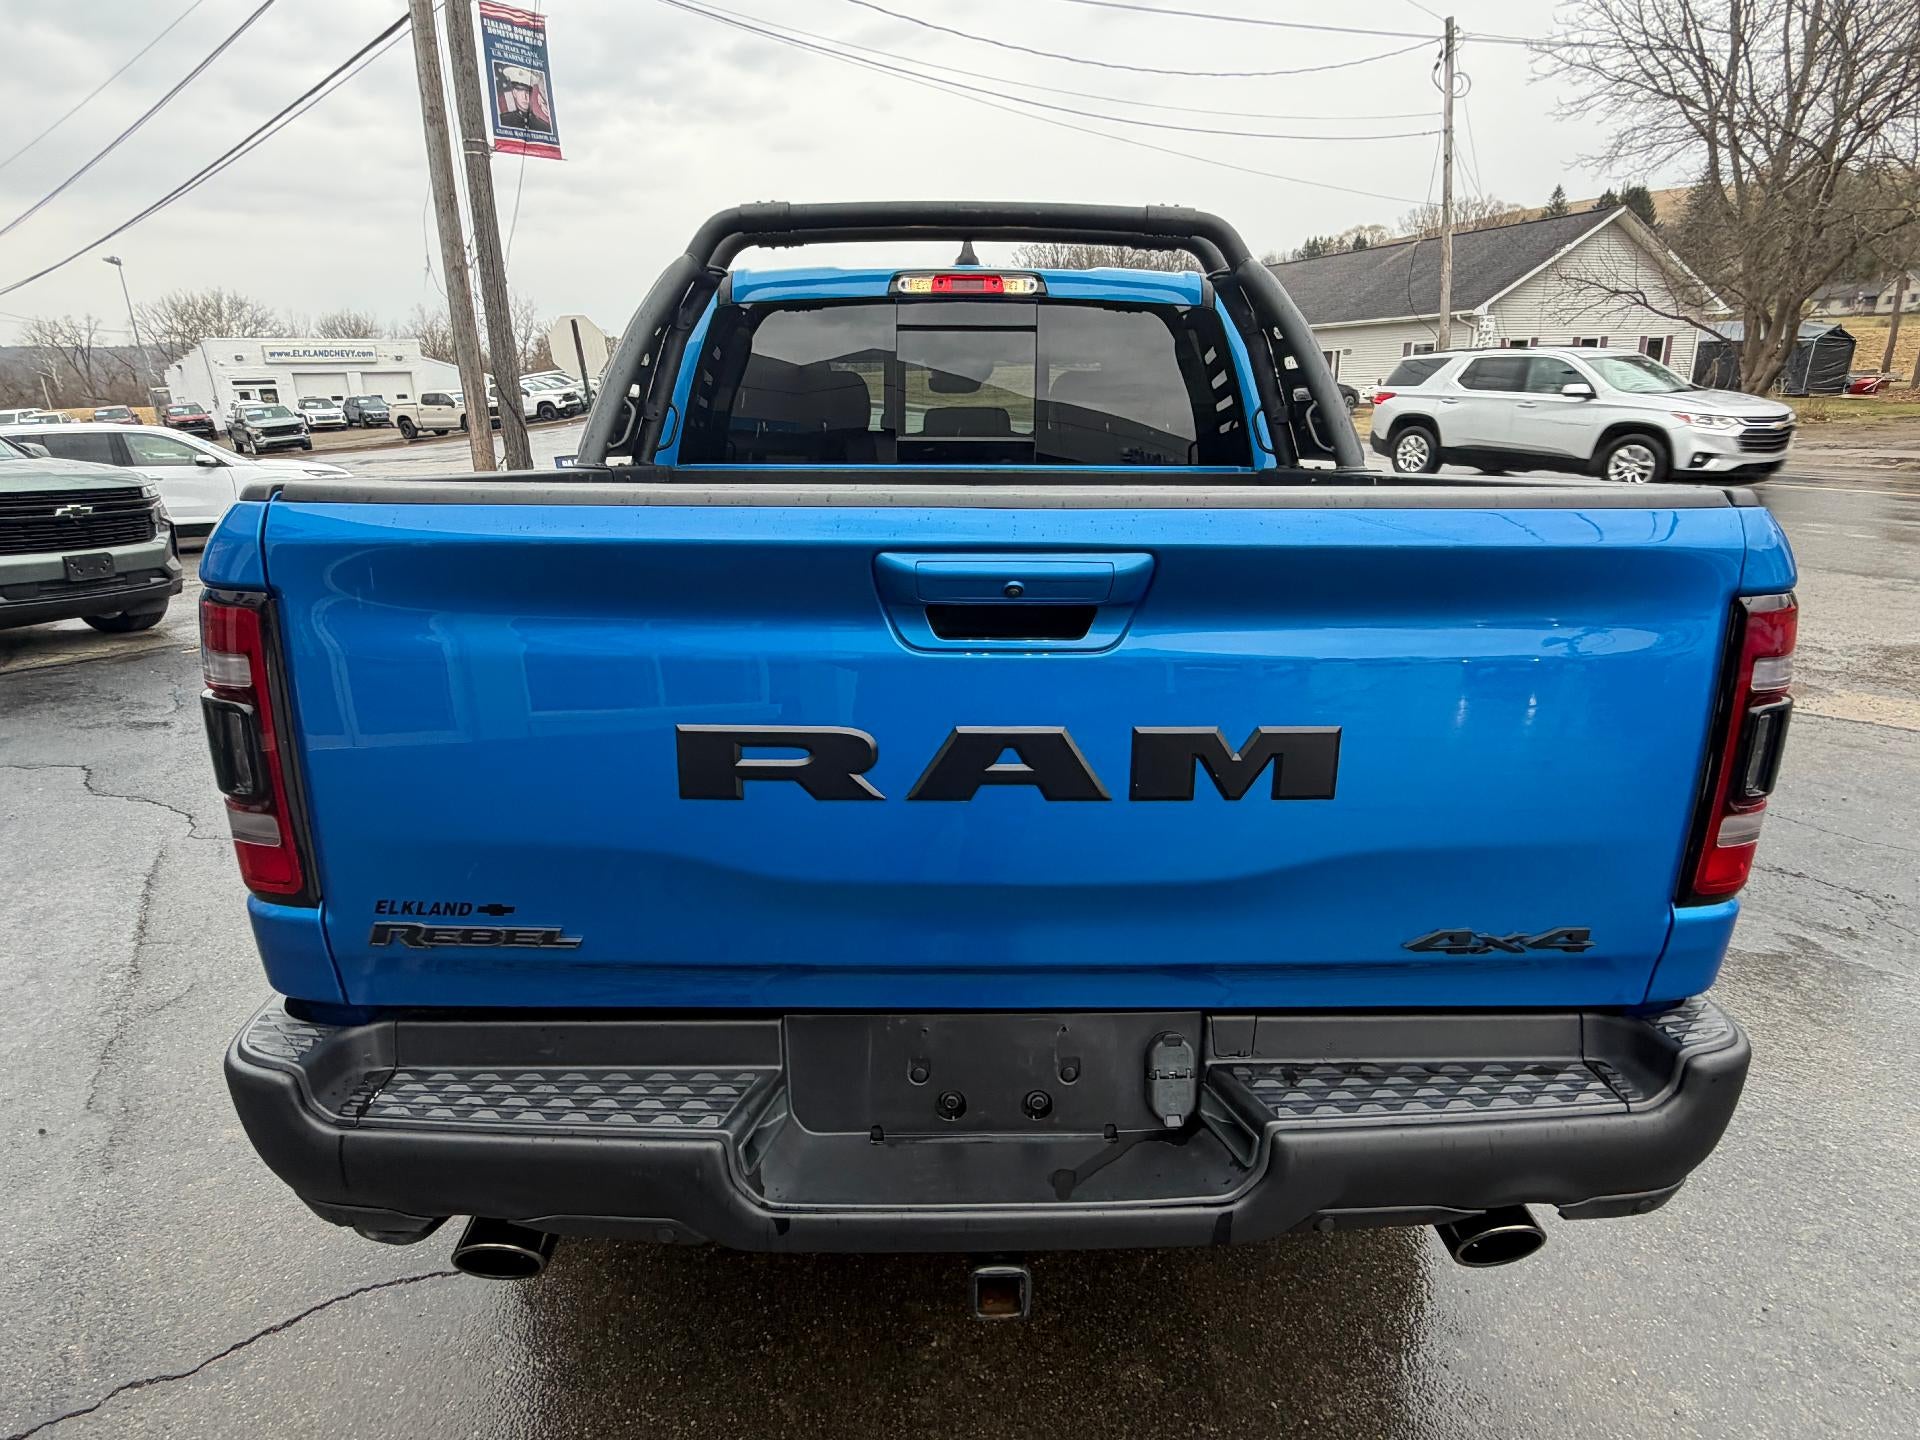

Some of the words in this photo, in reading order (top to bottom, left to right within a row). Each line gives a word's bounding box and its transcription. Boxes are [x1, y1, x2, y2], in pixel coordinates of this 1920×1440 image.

[483, 18, 512, 32] ELKLAND
[513, 26, 545, 41] BOROUGH
[487, 26, 524, 42] HOMETOWN
[503, 52, 525, 64] MARINE
[269, 349, 374, 358] www.ELKLANDCHEVY.com
[676, 723, 1343, 802] RAM
[374, 900, 473, 917] ELKLAND
[369, 920, 585, 949] REBEL
